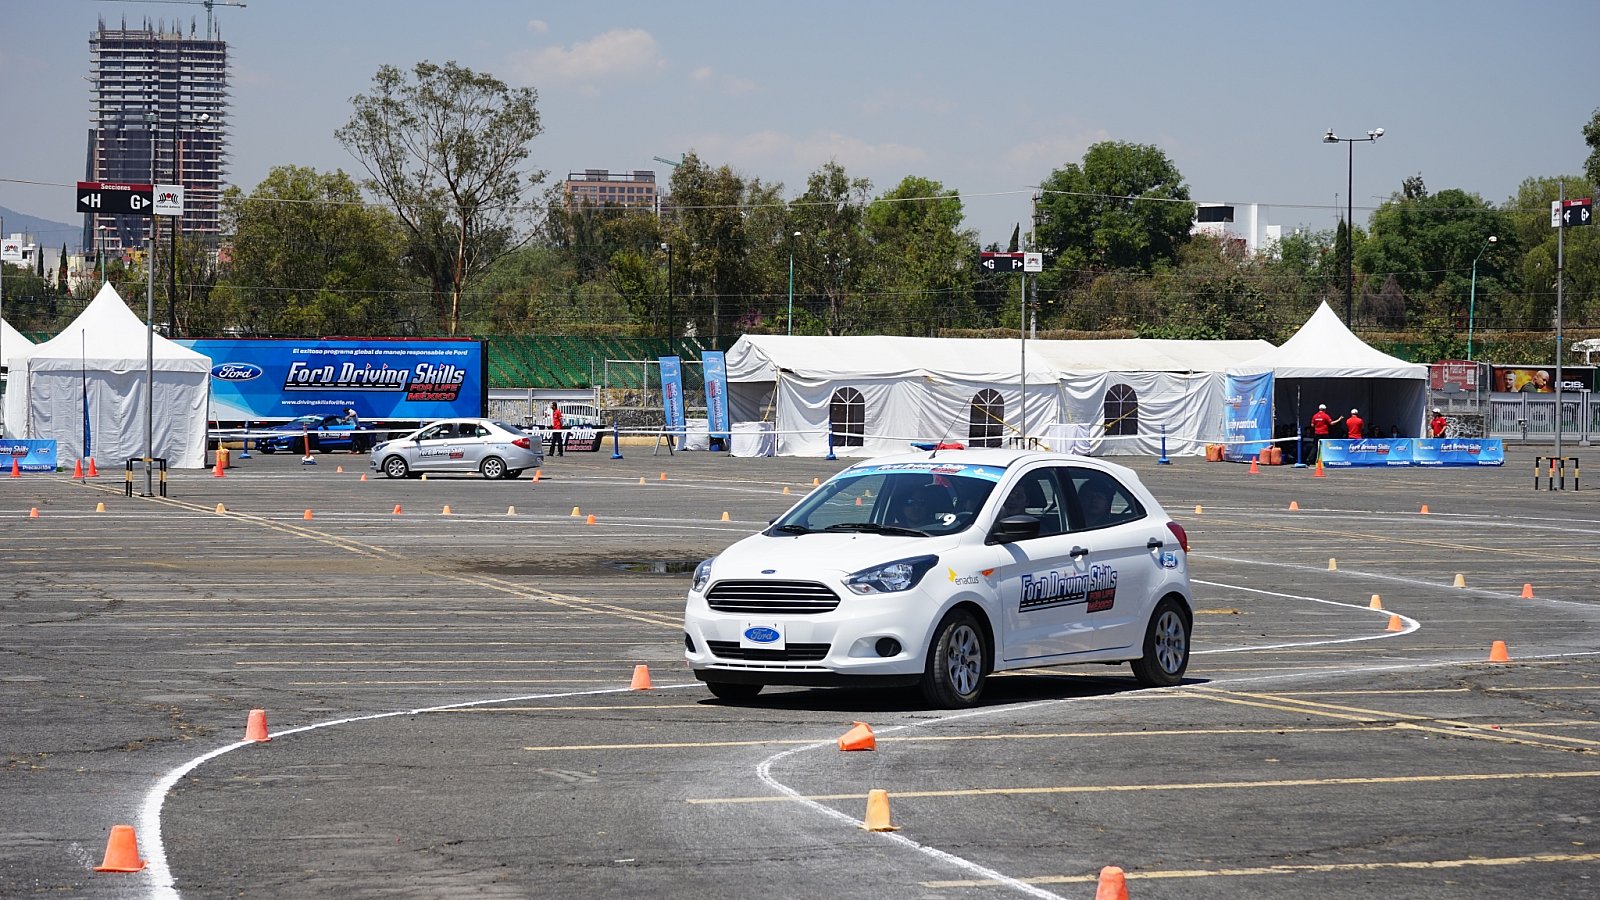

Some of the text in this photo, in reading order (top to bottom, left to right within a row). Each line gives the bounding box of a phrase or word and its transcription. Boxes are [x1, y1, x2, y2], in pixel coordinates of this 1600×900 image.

[90, 194, 101, 208] H
[130, 194, 141, 210] G
[1567, 210, 1571, 223] F
[1581, 208, 1586, 221] G
[989, 260, 994, 269] G
[1012, 260, 1017, 269] F
[219, 365, 252, 378] Ford
[337, 362, 409, 391] Driving
[412, 363, 465, 384] Skills
[943, 513, 956, 526] 9
[955, 575, 979, 585] enactus
[1047, 571, 1089, 601] Driving
[1088, 564, 1117, 590] Skills
[751, 629, 774, 639] Ford
